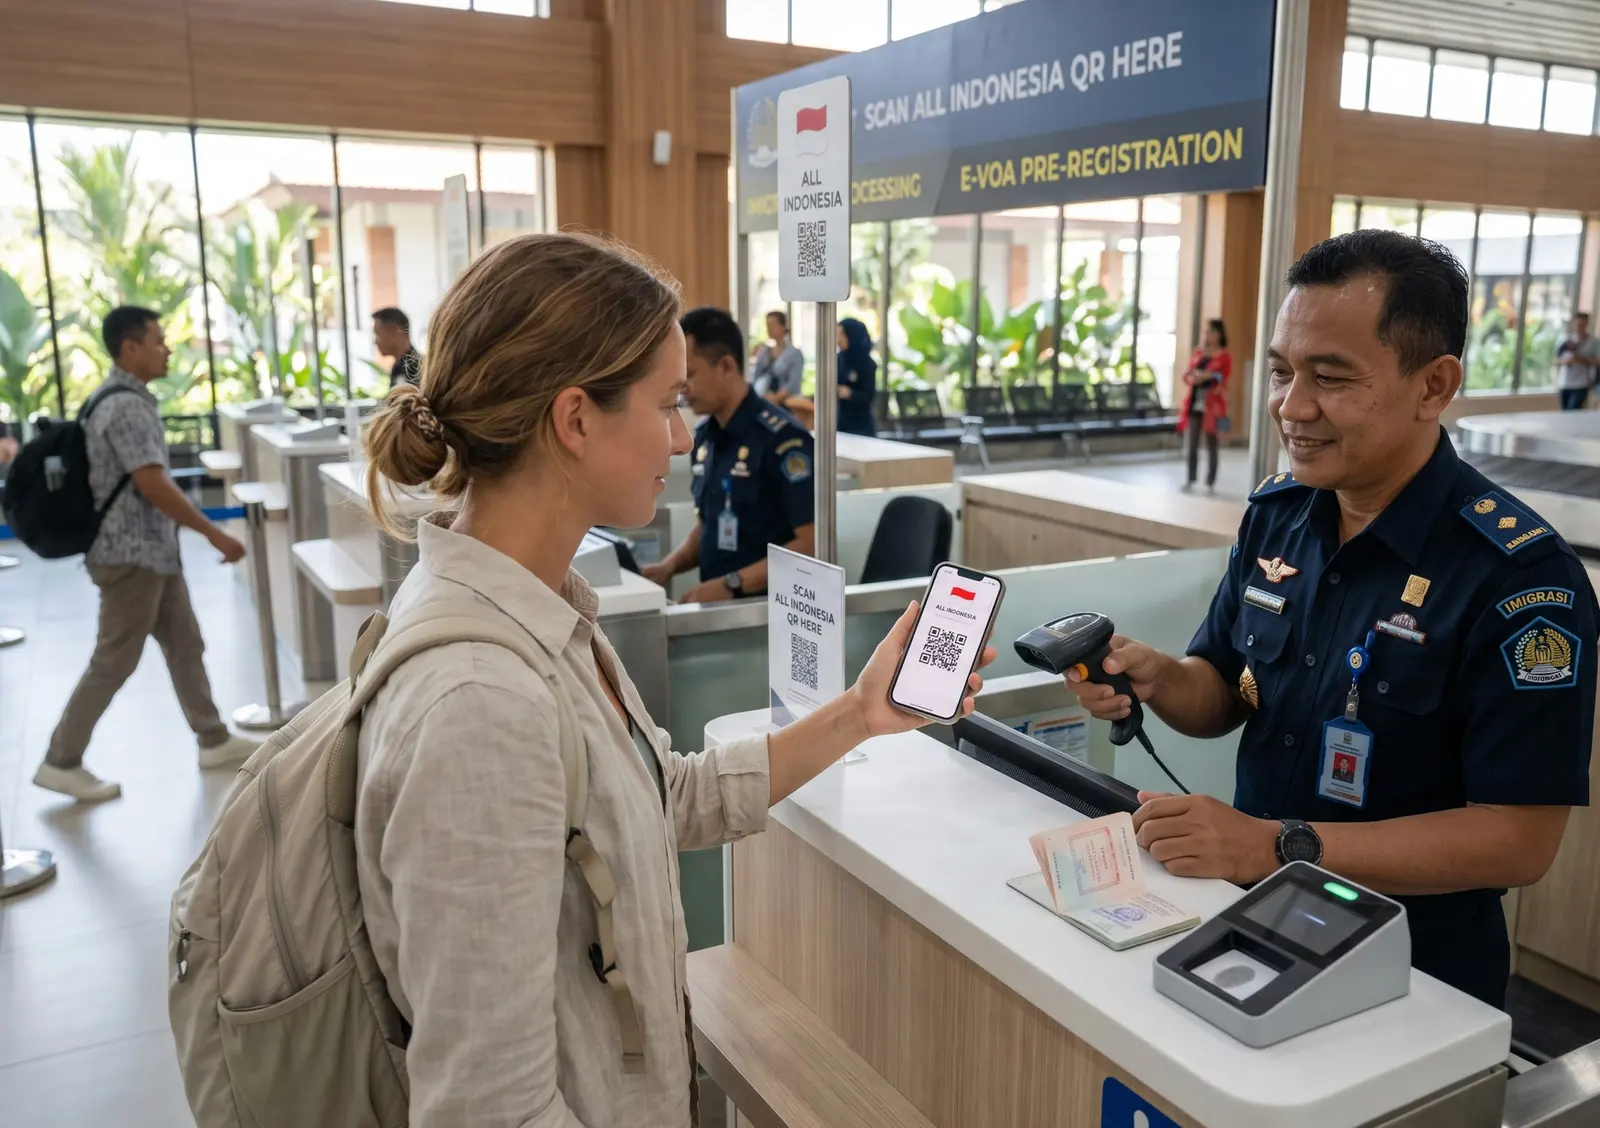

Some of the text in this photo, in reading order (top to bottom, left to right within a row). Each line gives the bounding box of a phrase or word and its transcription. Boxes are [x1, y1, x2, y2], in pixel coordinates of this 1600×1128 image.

[864, 96, 909, 131] SCAN
[912, 88, 946, 123] ALL
[951, 61, 1065, 111] INDONESIA
[1070, 51, 1105, 92] QR
[1112, 31, 1183, 80] HERE
[961, 127, 1244, 192] E-VOA PRE-REGISTRATION
[801, 169, 822, 187] ALL
[852, 173, 921, 205] OCESSING
[783, 190, 843, 212] INDONESIA
[793, 584, 816, 601] SCAN
[1504, 591, 1568, 613] IMIGRASI
[775, 593, 835, 625] ALL INDONESIA
[935, 604, 946, 612] ALL
[946, 607, 977, 620] INDONESIA
[787, 613, 822, 636] QR HERE
